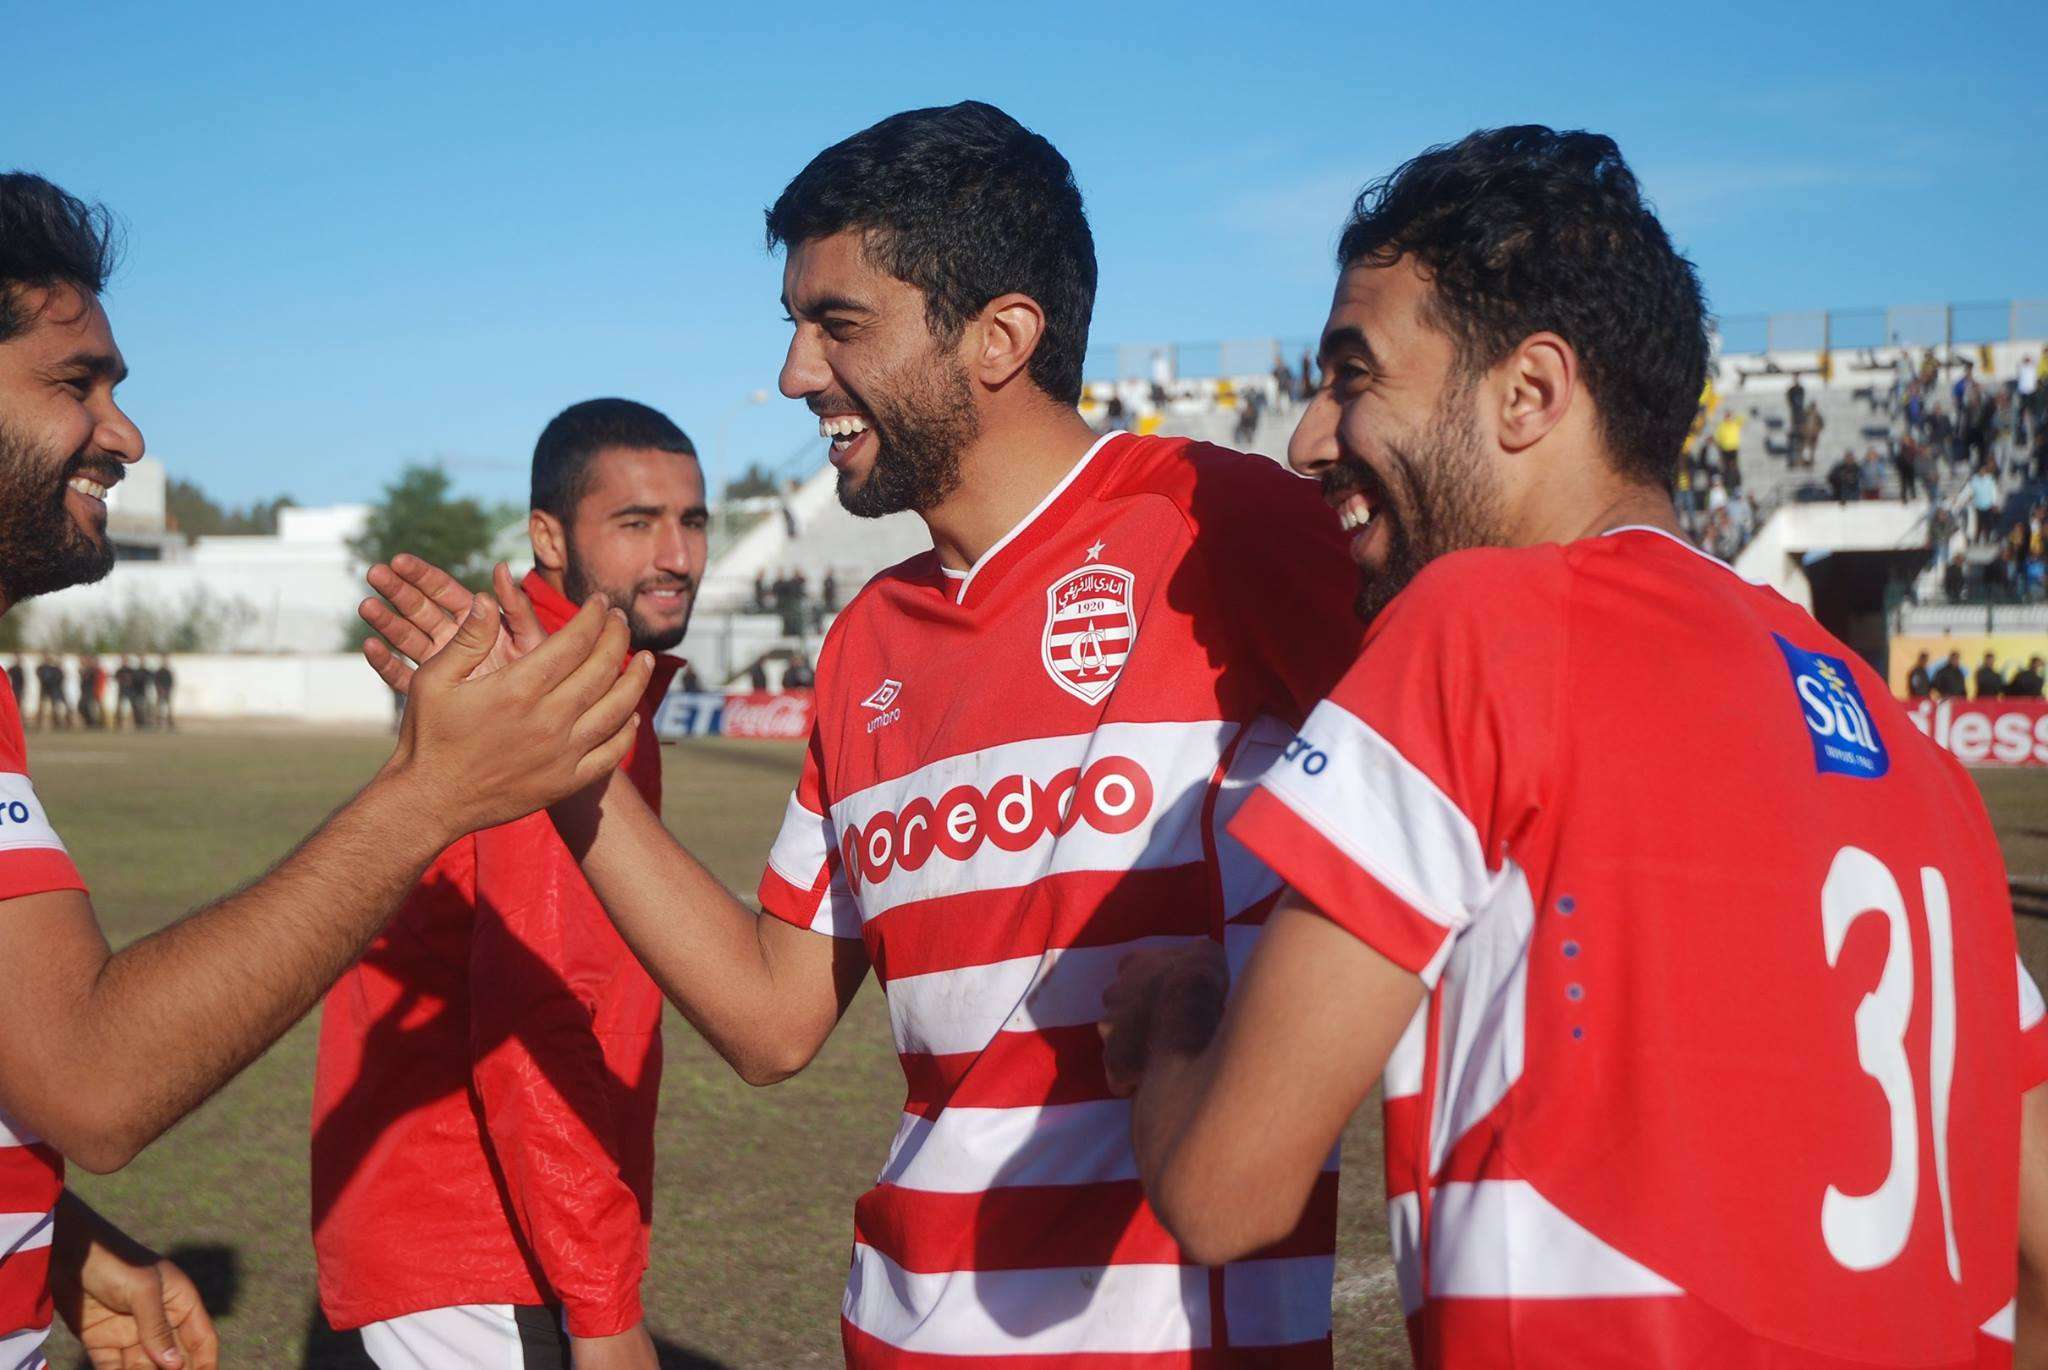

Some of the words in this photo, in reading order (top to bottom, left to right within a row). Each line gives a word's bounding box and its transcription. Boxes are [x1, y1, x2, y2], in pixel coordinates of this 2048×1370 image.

[1077, 600, 1105, 614] 1920
[656, 696, 726, 736] ET
[867, 708, 901, 733] umbro
[0, 801, 29, 826] ro
[1821, 846, 1963, 1284] 31
